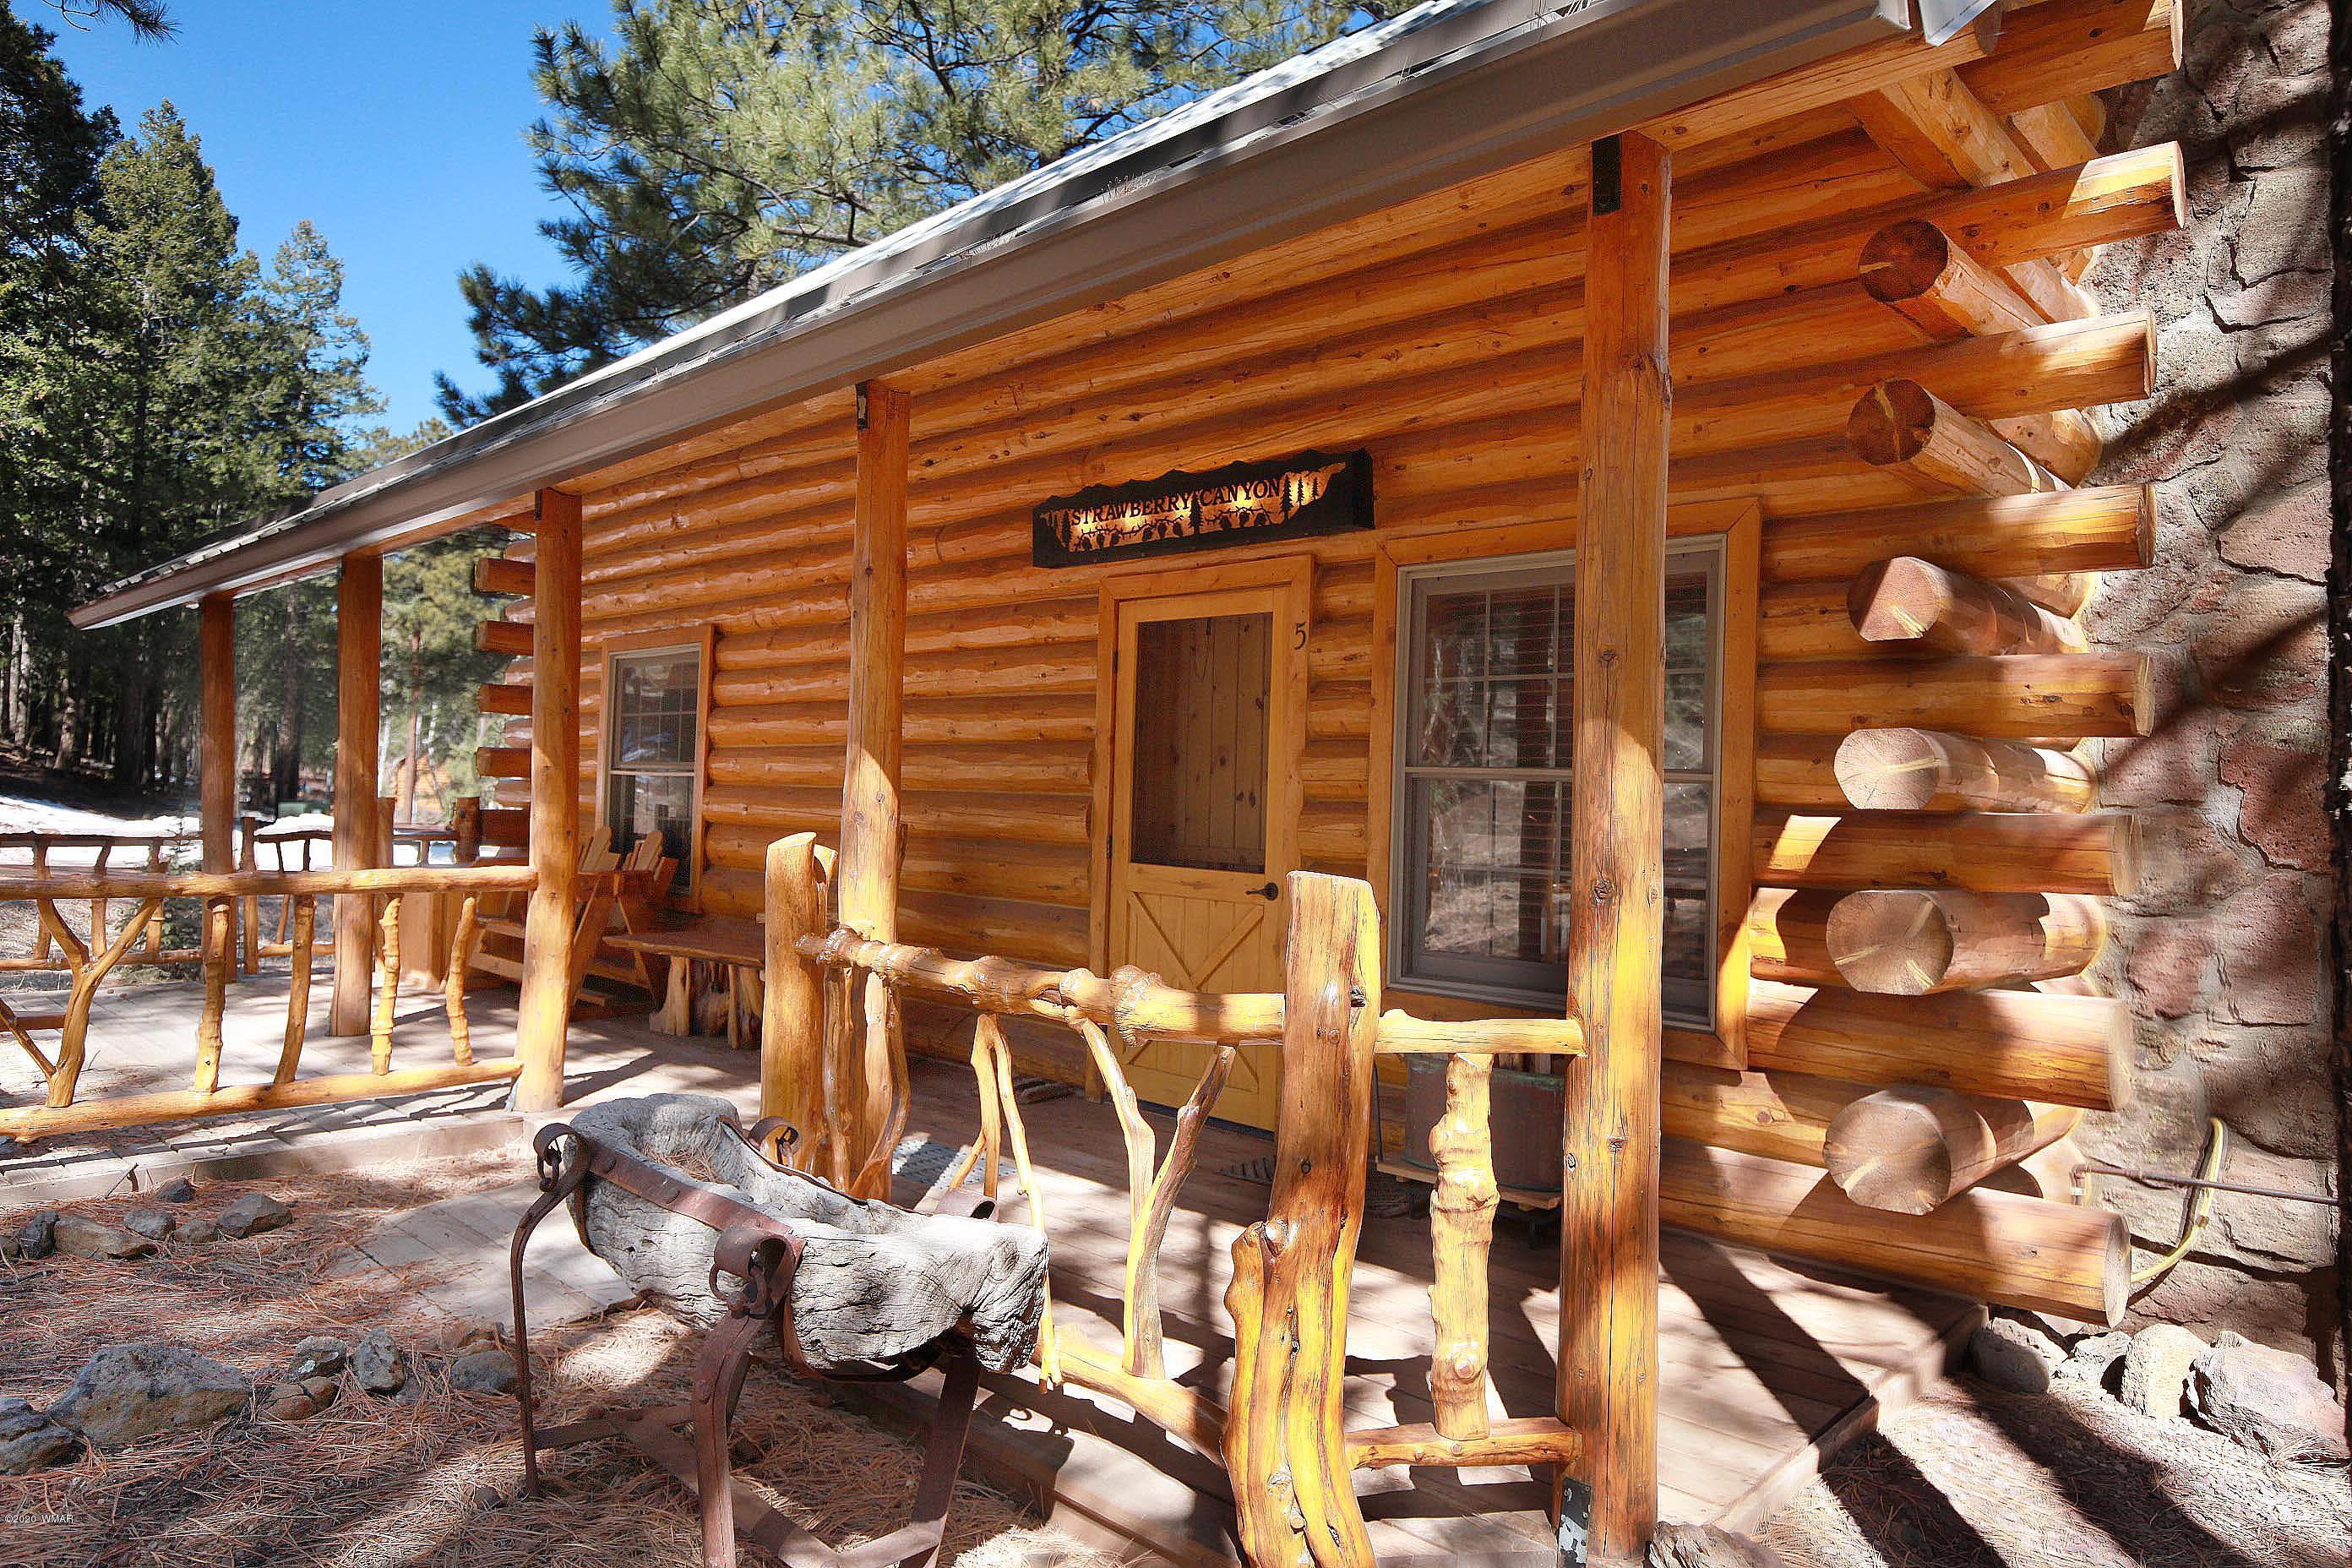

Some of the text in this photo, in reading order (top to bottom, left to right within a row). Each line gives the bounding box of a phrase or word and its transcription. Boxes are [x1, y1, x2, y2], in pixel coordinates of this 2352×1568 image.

[1071, 479, 1281, 525] STRAWBERRY CANYON
[1294, 622, 1306, 650] 5
